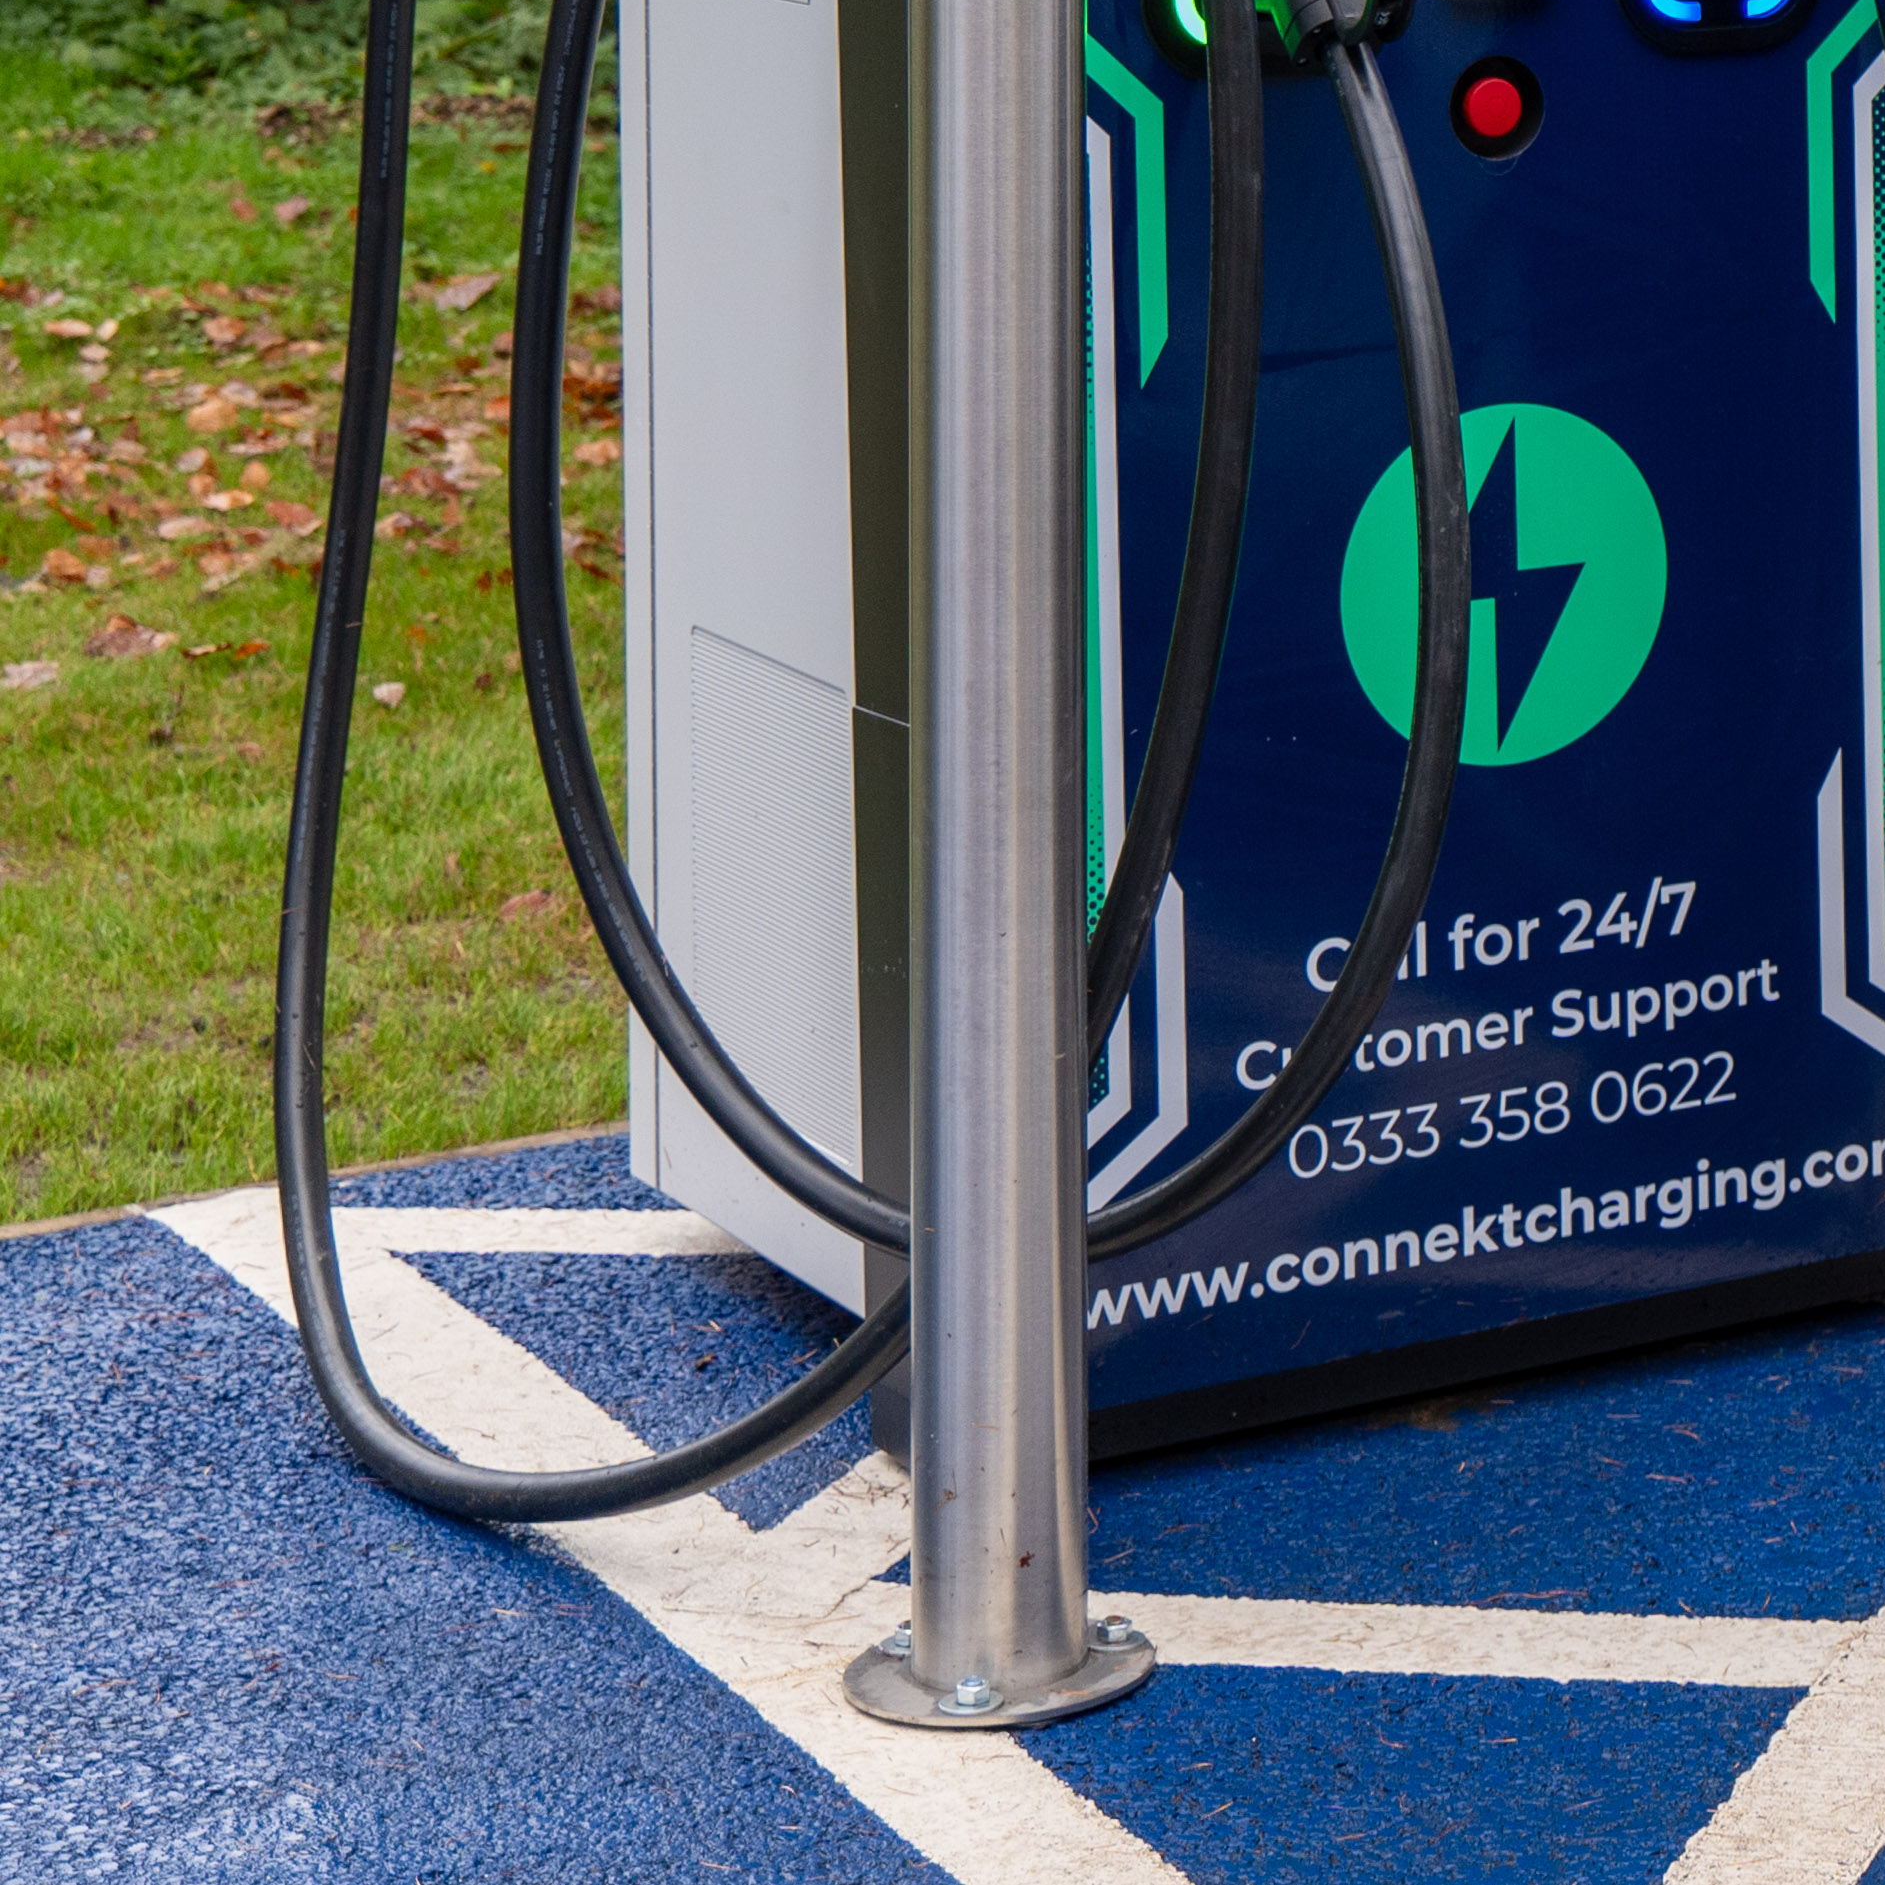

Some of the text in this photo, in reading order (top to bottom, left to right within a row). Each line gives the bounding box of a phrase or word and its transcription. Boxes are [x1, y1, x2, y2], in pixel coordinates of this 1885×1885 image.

[1306, 877, 1697, 993] Cl for 24/7
[1235, 959, 1781, 1091] Ctomer Support
[1289, 1051, 1737, 1179] 0333 358 0622
